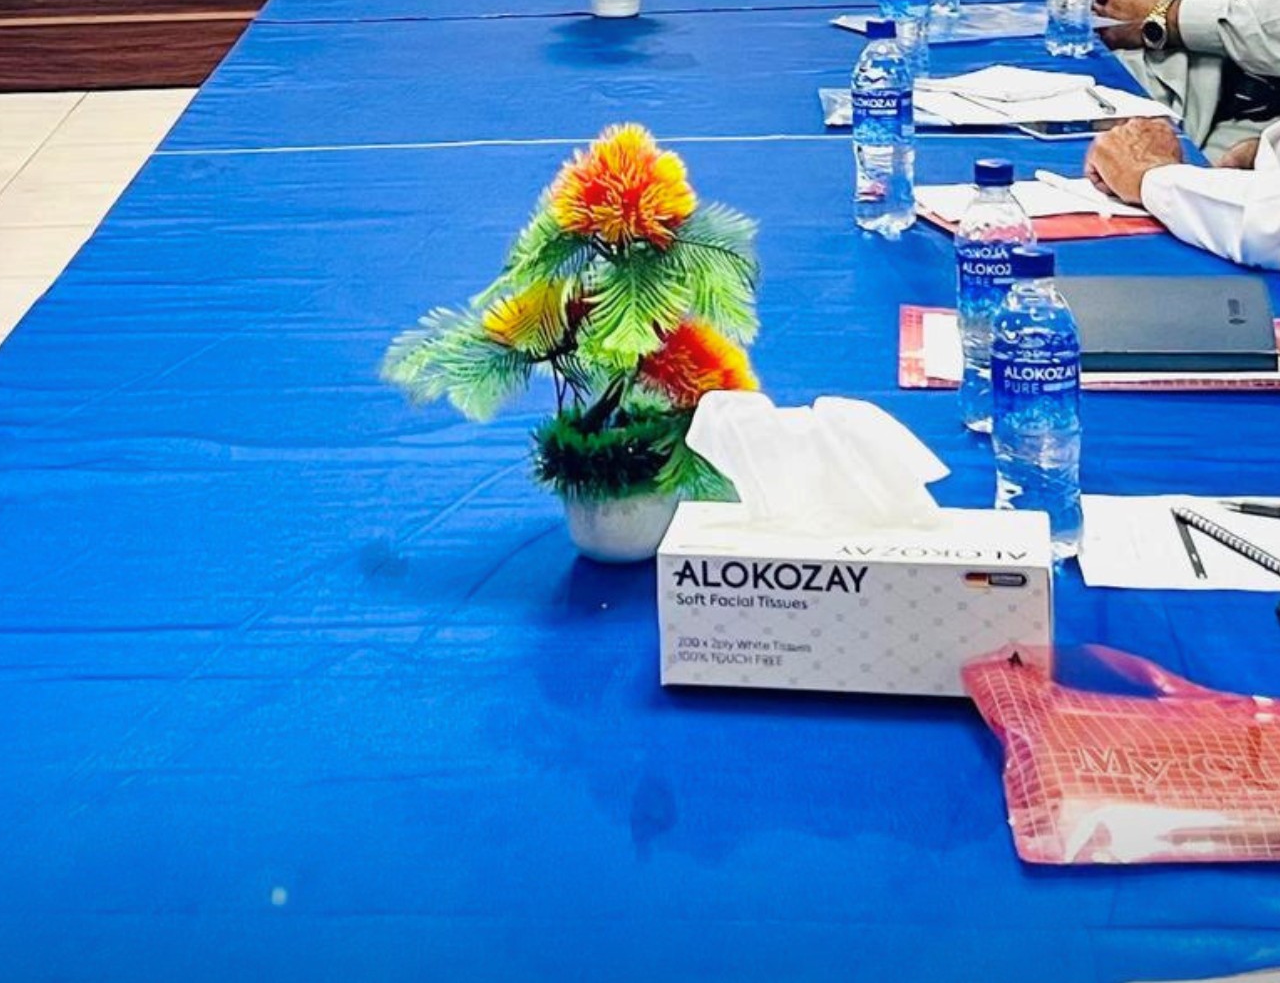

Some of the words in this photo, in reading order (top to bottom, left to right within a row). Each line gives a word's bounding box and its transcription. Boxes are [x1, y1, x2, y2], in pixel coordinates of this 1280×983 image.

[1004, 379, 1039, 394] PURE
[672, 559, 869, 593] ALOKOZAY
[676, 592, 706, 606] Soft
[710, 594, 754, 608] Facial
[757, 595, 808, 610] Tissues
[736, 639, 770, 651] White
